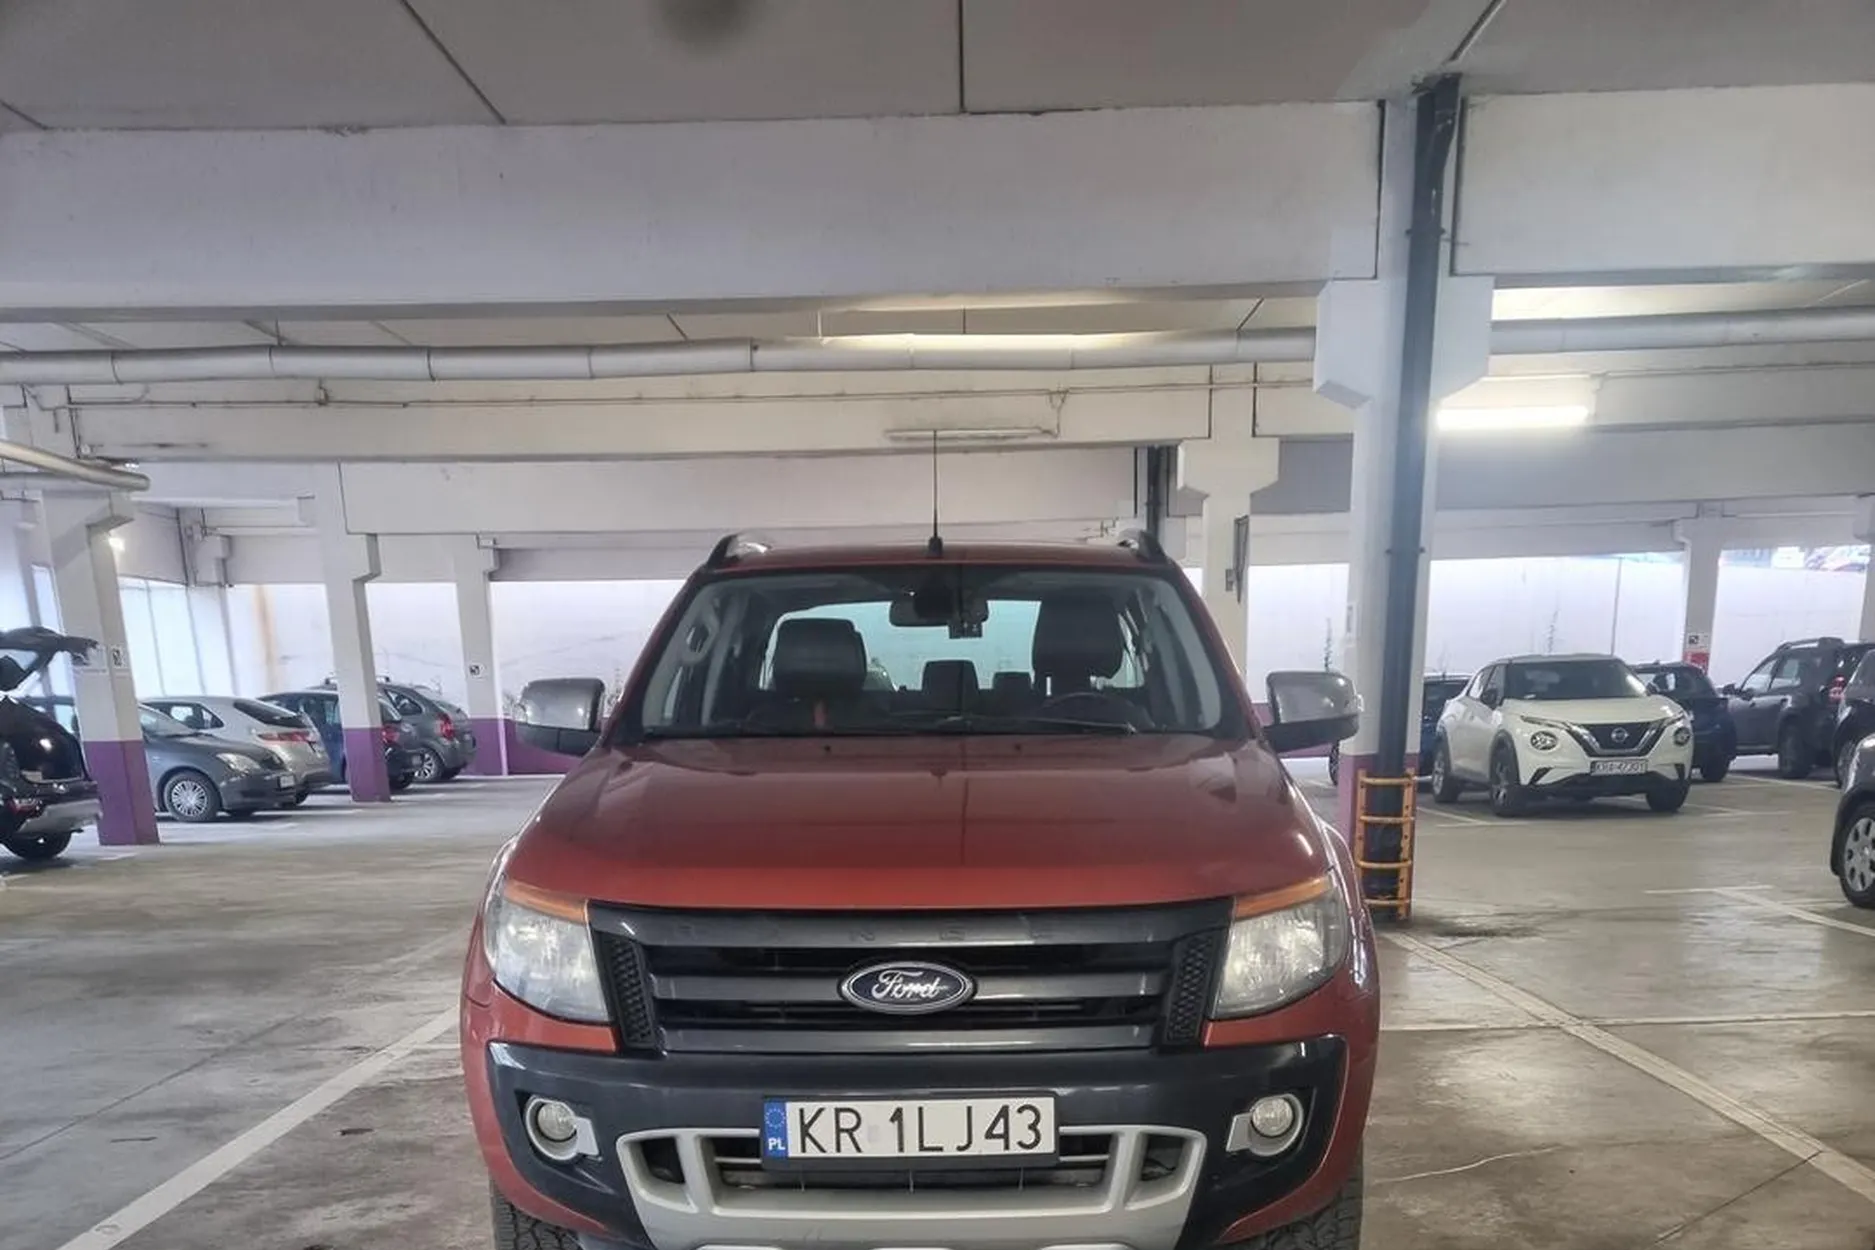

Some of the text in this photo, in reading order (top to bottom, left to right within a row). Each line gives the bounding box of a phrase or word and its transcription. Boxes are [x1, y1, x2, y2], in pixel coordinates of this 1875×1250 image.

[872, 969, 948, 999] Ford
[798, 1104, 1042, 1153] KR 1LJ43
[768, 1138, 786, 1151] PL
